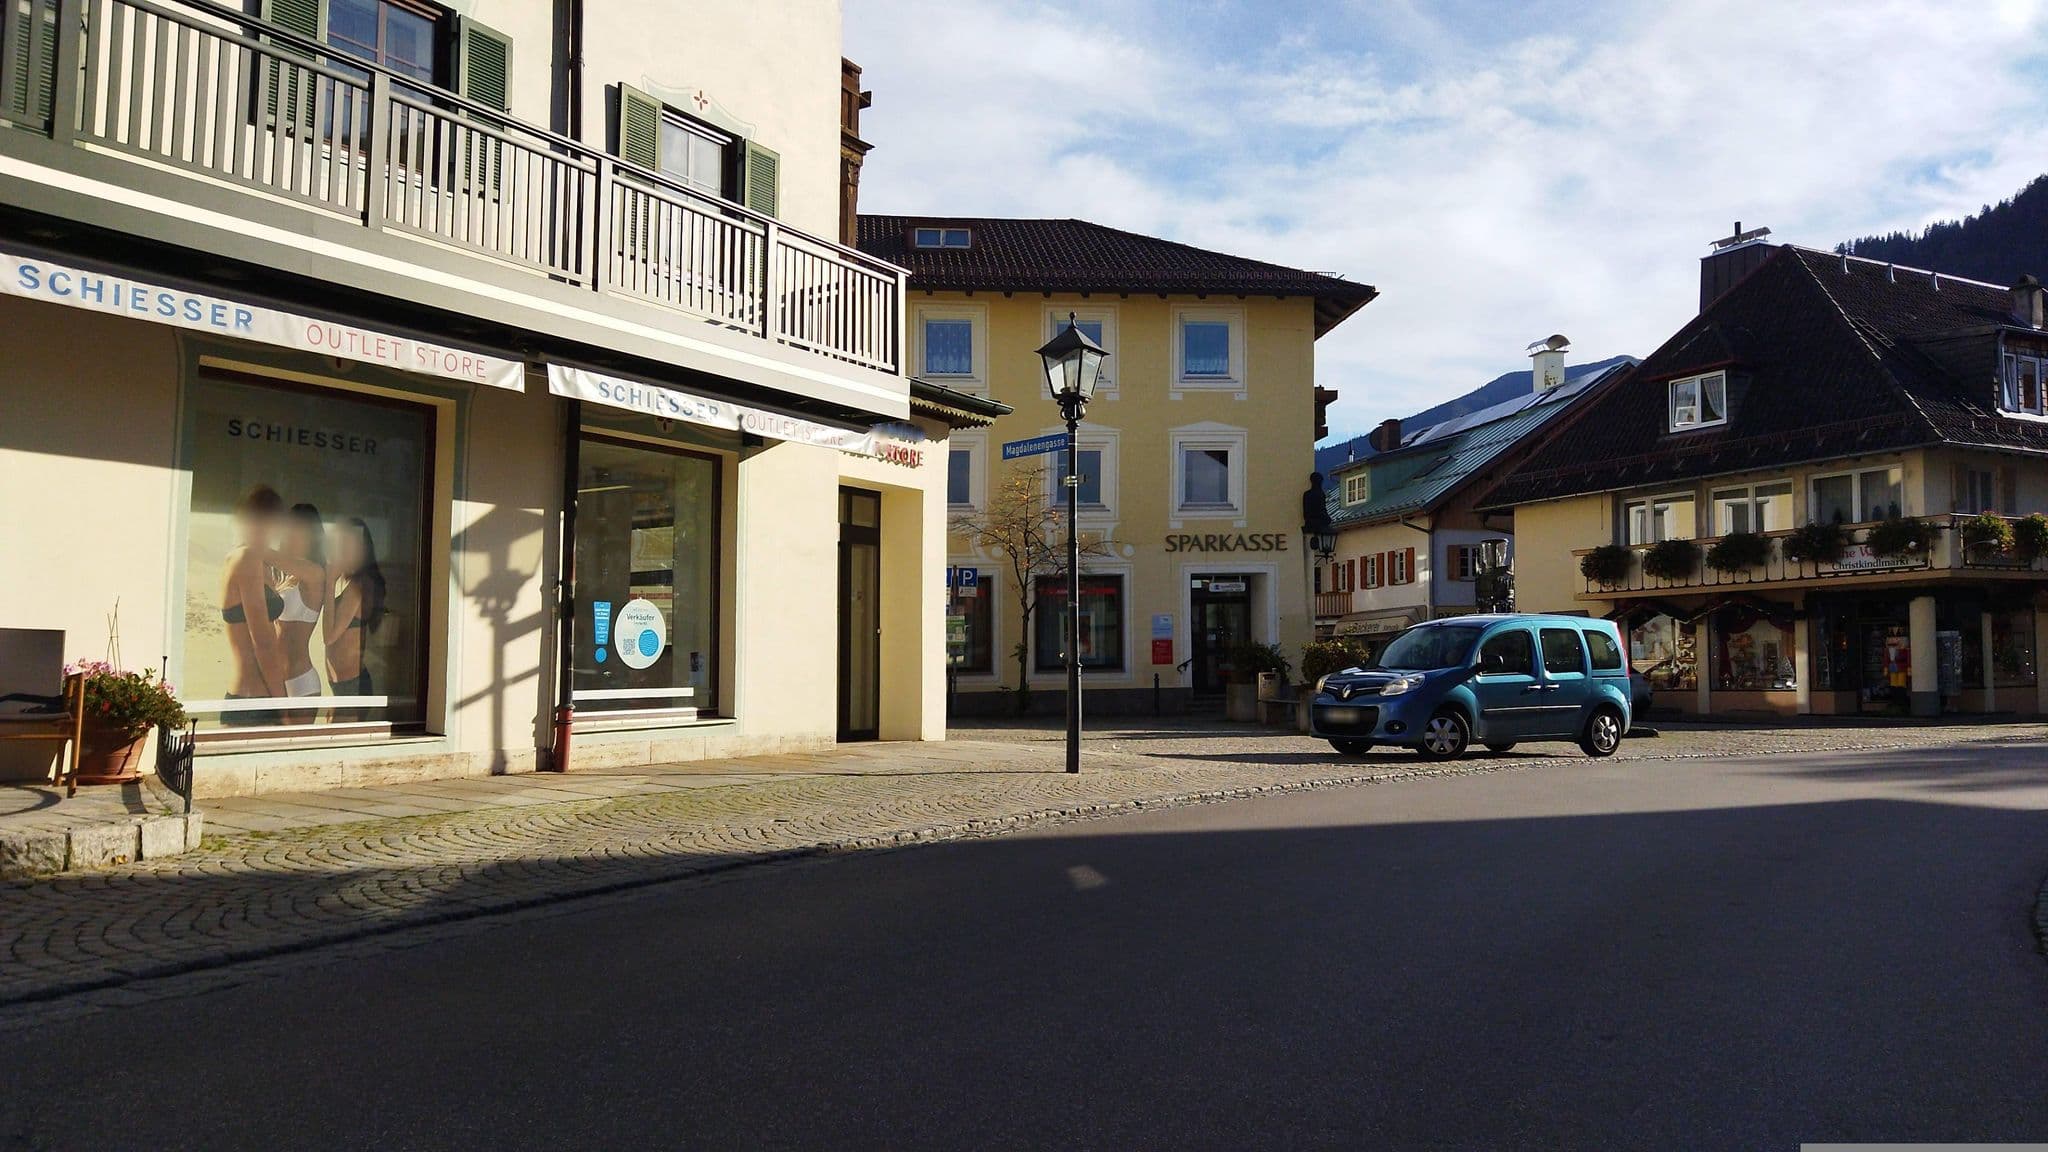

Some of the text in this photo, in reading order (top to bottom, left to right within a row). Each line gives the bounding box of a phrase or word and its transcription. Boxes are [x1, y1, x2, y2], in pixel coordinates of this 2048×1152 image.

[18, 264, 487, 378] SCHIESSER OUTLET STORE
[746, 413, 797, 437] OUTLET
[228, 419, 377, 454] SCHIESSER
[1006, 438, 1065, 456] Magdalenengasse
[1165, 533, 1288, 552] SPARKASSE
[962, 570, 973, 585] P
